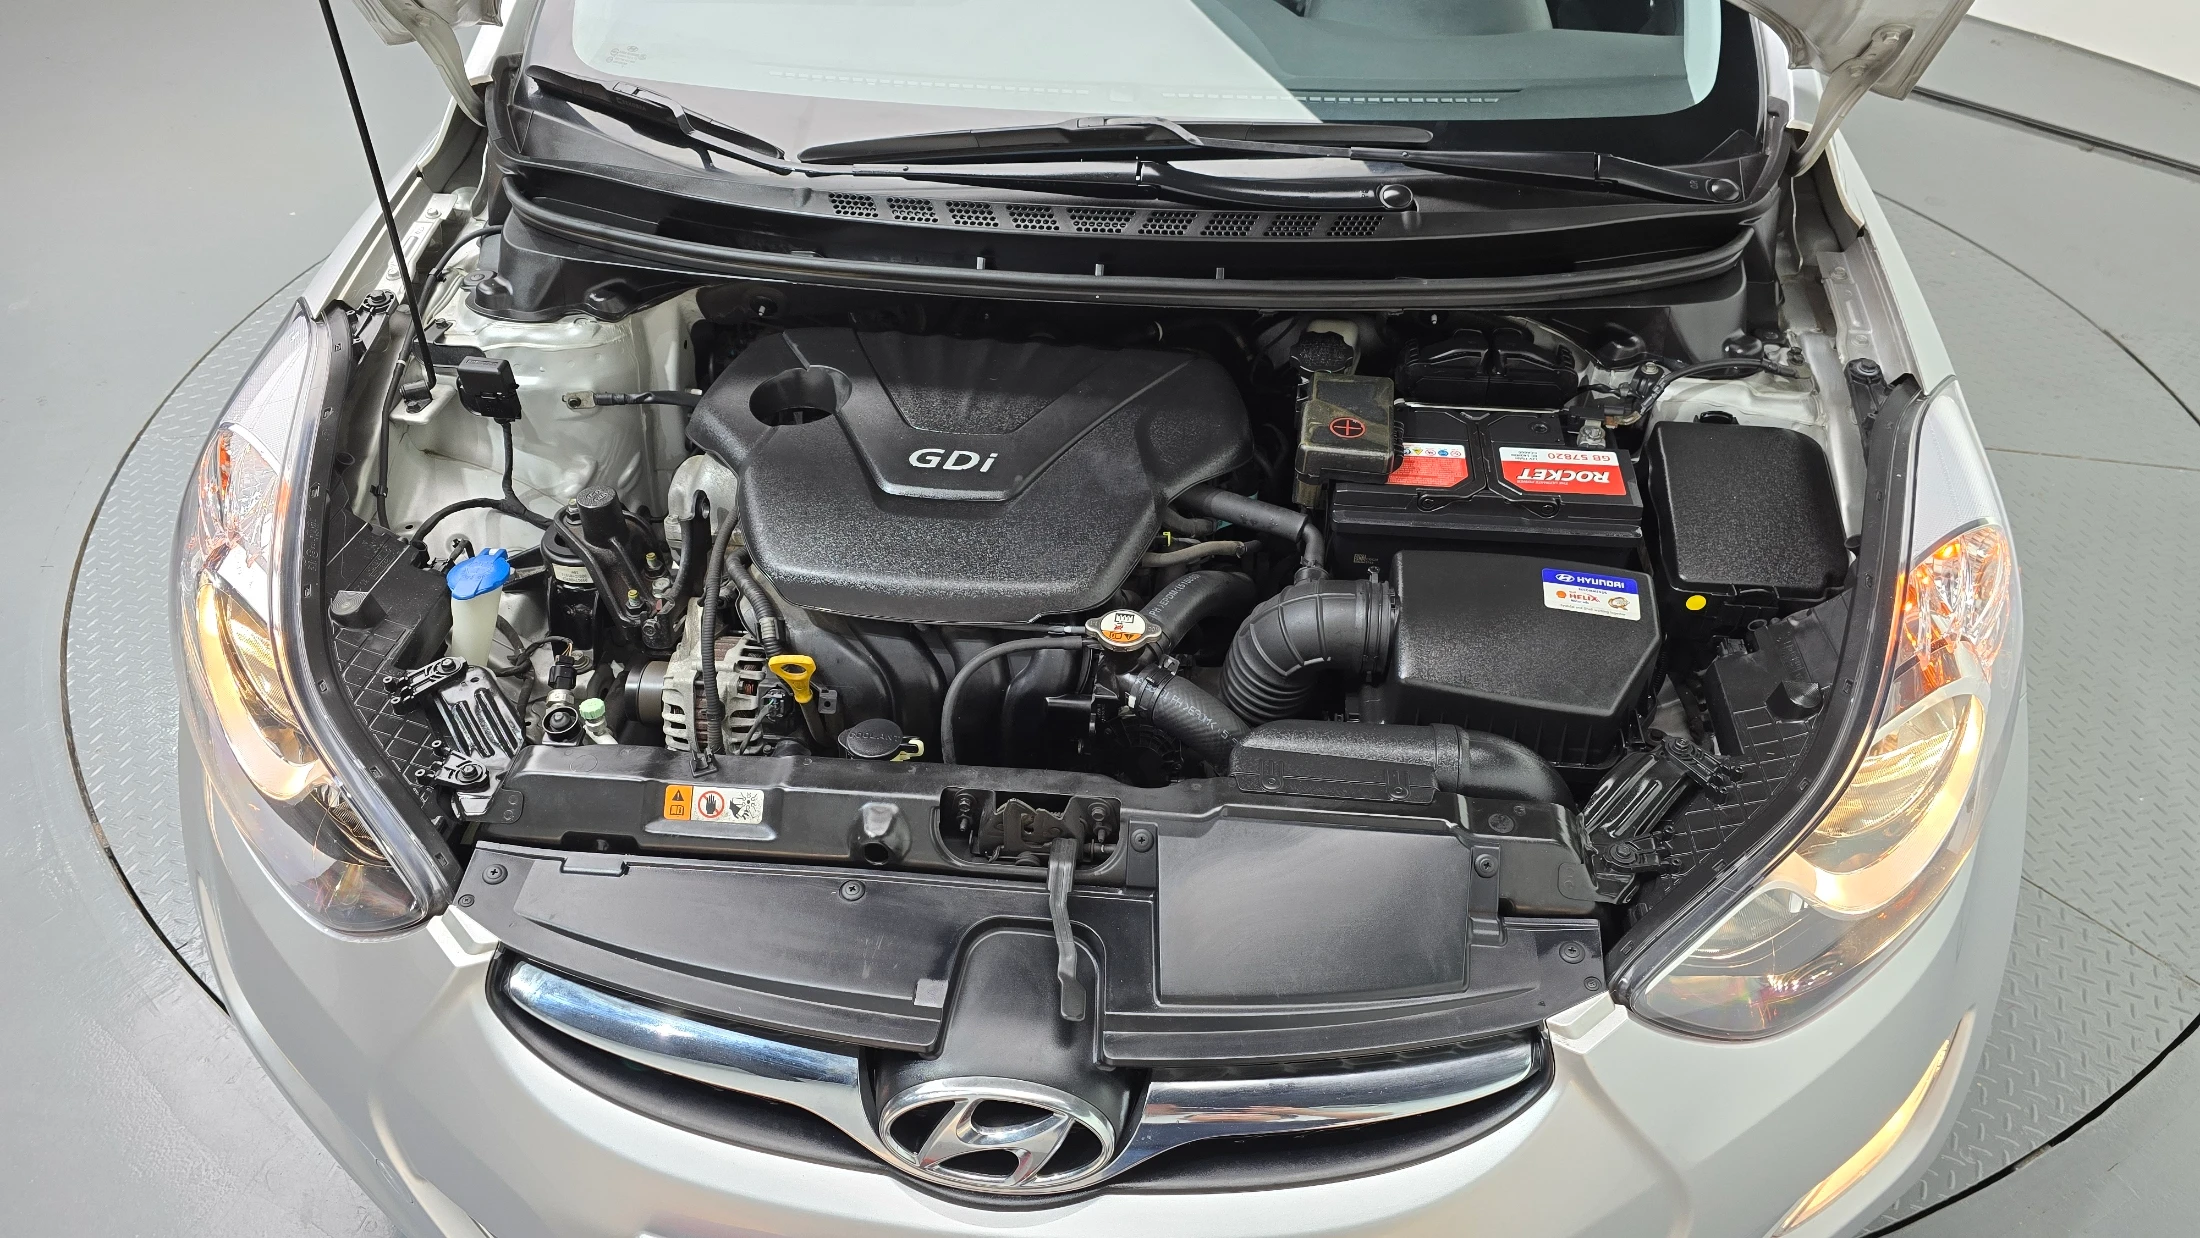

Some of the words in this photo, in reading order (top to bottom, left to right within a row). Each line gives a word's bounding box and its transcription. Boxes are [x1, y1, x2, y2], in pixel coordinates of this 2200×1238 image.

[908, 448, 999, 473] GDi
[1547, 452, 1588, 461] 57820
[1592, 454, 1611, 462] GB
[1516, 468, 1610, 484] ROCKET
[1576, 576, 1625, 589] HYUNDAI
[1569, 593, 1600, 602] HELIX
[848, 731, 902, 742] COOLANT
